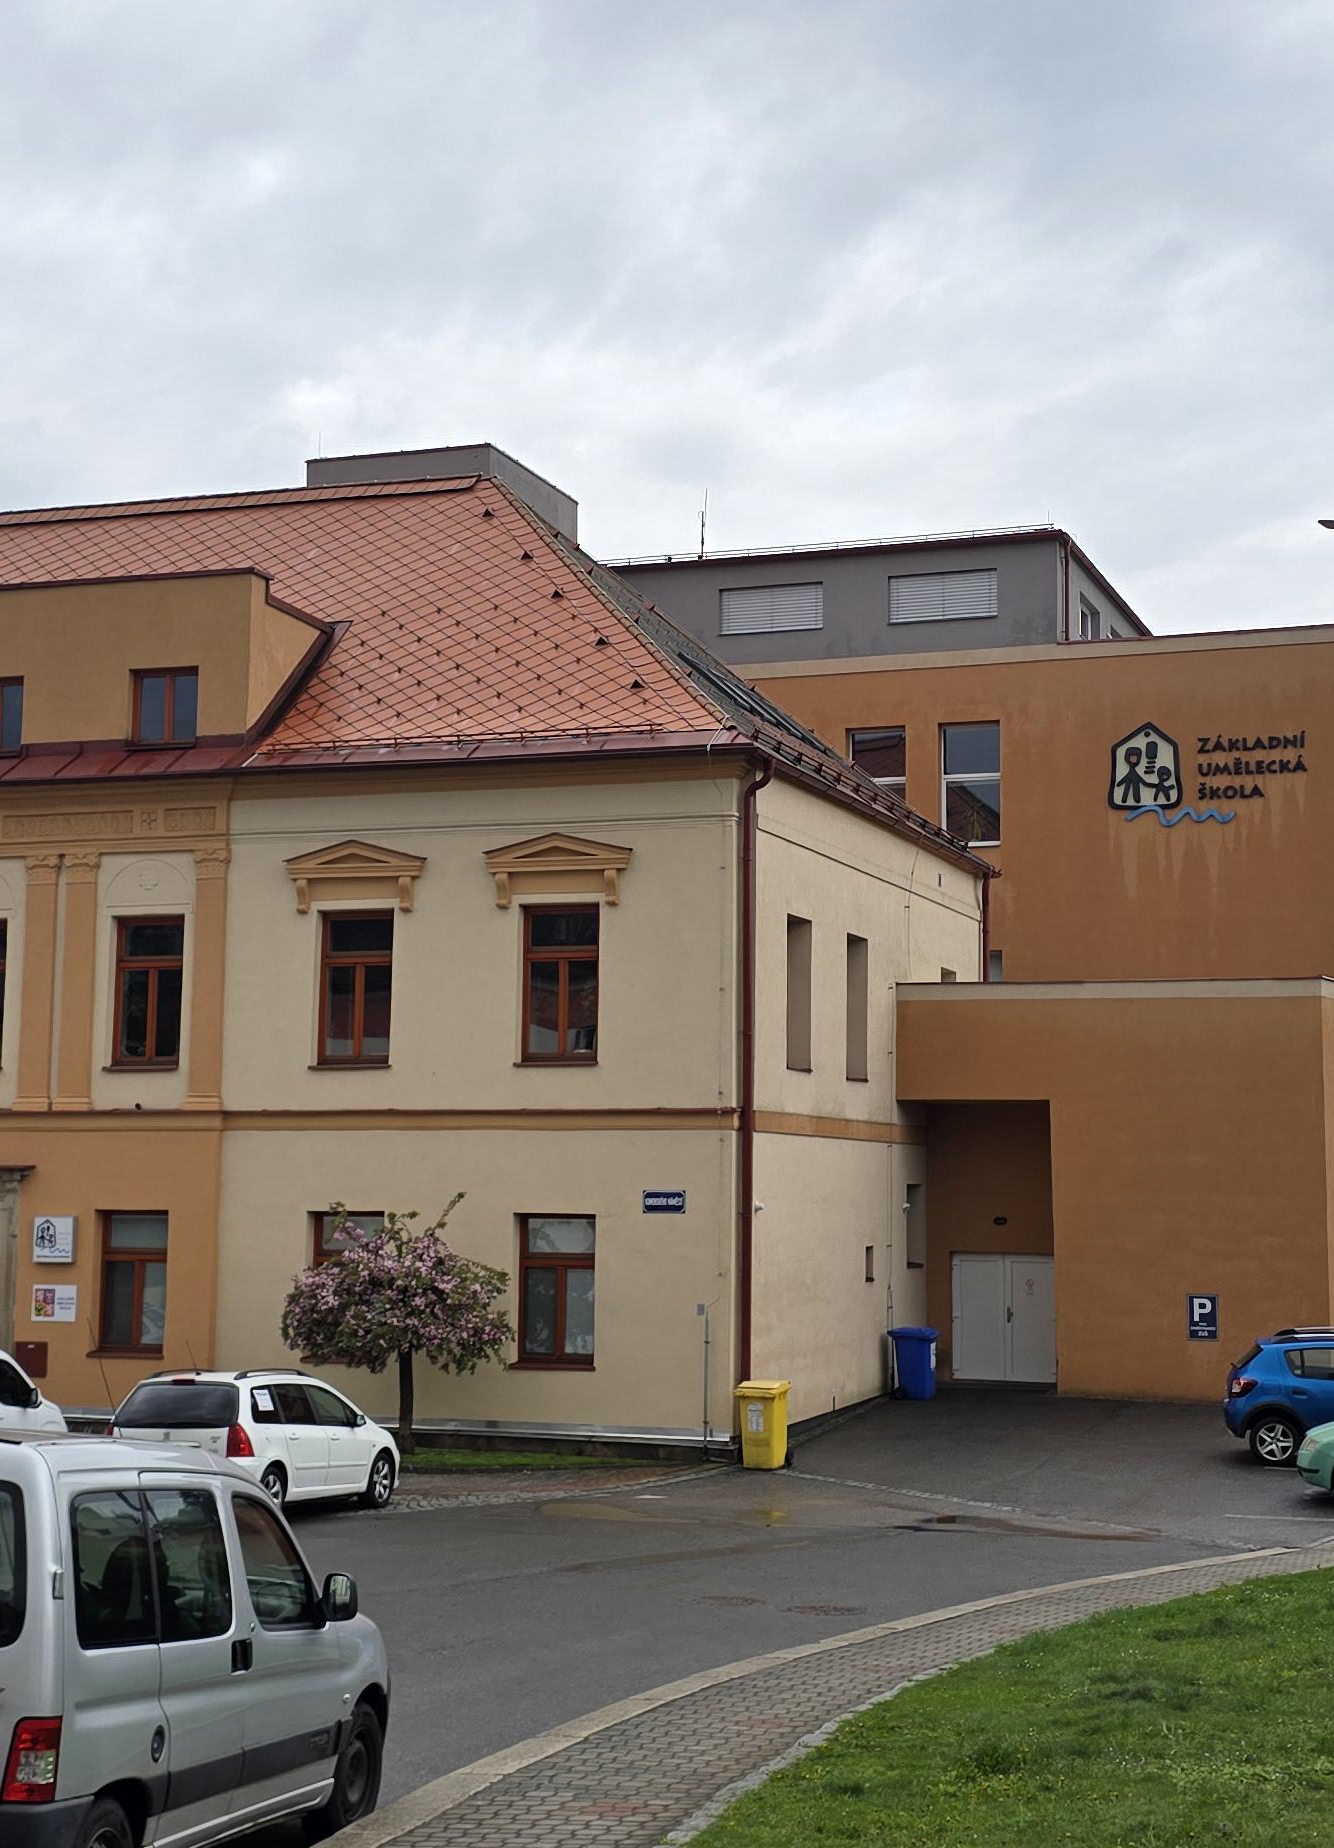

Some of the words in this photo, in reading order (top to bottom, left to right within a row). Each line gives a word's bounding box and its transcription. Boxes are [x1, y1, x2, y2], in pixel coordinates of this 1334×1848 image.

[1197, 730, 1306, 754] ZÁKLADNÍ
[1197, 755, 1307, 777] UMĚLECKÁ
[1198, 783, 1264, 801] ŠKOLA
[1193, 1298, 1212, 1321] P
